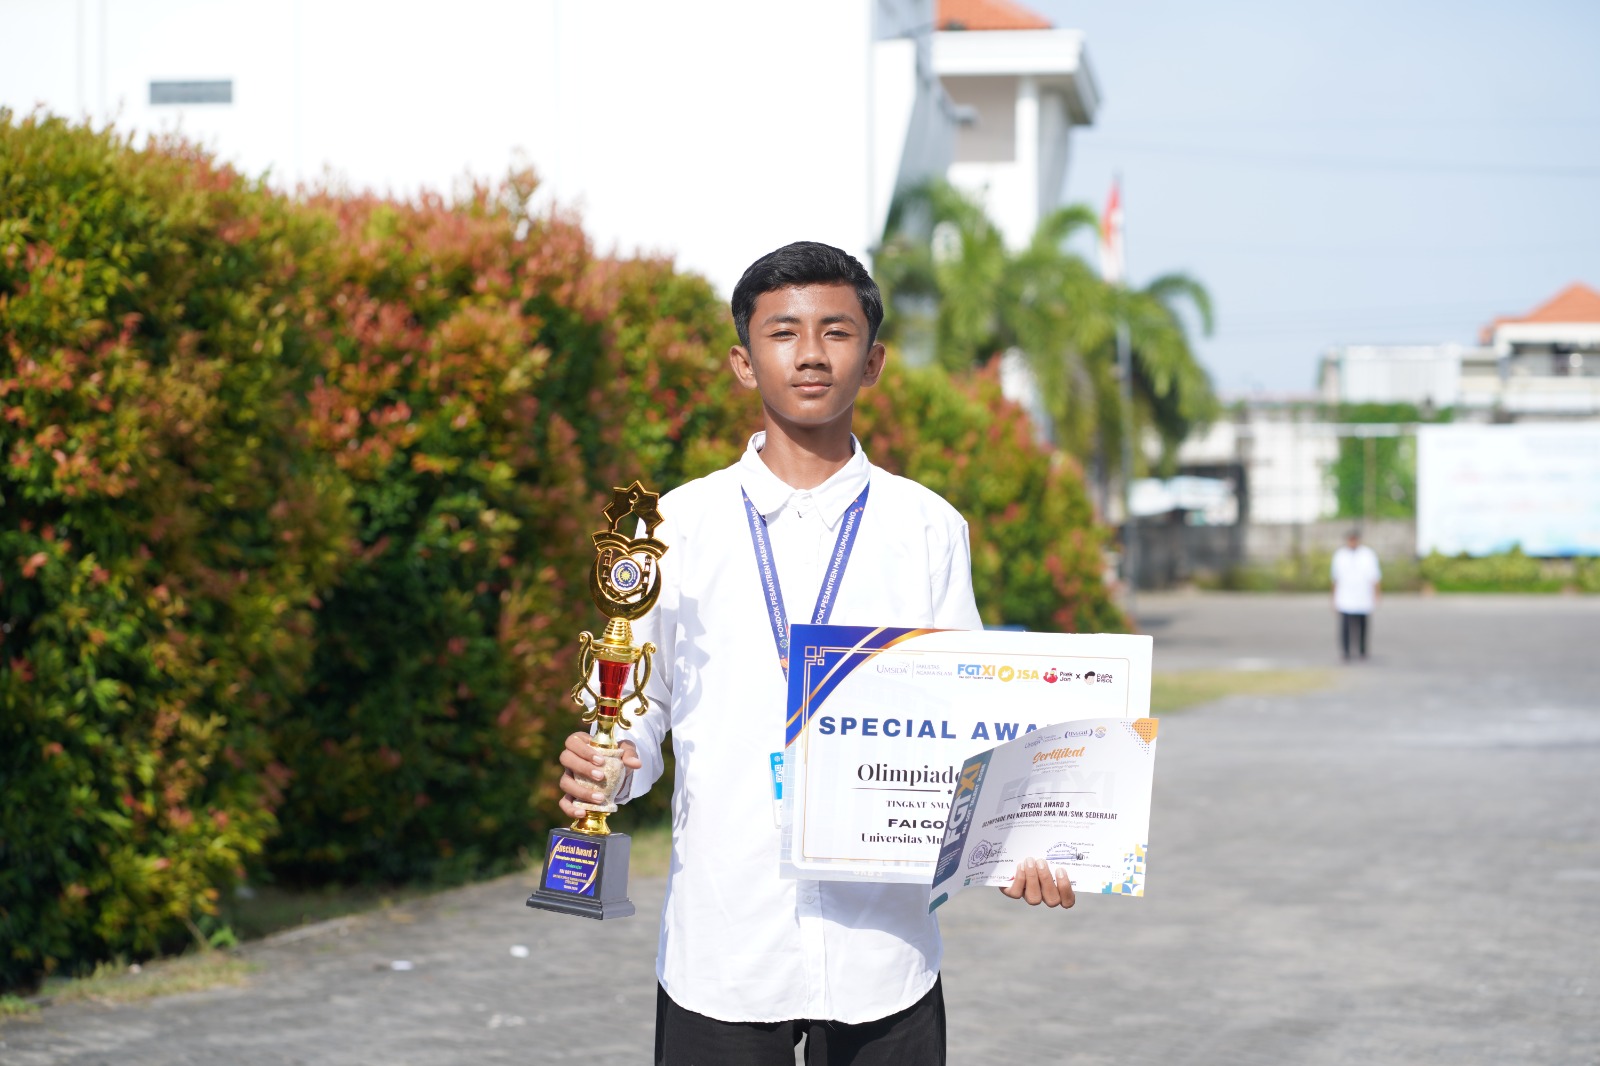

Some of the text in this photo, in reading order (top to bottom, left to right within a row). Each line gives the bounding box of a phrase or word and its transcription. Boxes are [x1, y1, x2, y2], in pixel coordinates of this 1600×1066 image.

[821, 567, 838, 609] PESANTREN
[836, 511, 856, 569] MASKUMAMBANG
[750, 506, 785, 637] PONDOK PESANTREN MASKUMAMBANG
[1016, 670, 1039, 680] JSA
[818, 716, 956, 739] SPECIAL
[971, 721, 1049, 741] AWA
[1032, 746, 1086, 764] Sertifikat
[886, 800, 927, 809] TINGKAT
[943, 762, 982, 848] FGTXI
[1085, 812, 1118, 820] SEDERAJAT
[888, 818, 948, 829] FAI GO
[861, 832, 922, 844] Universitas
[556, 845, 597, 858] Special Award 3
